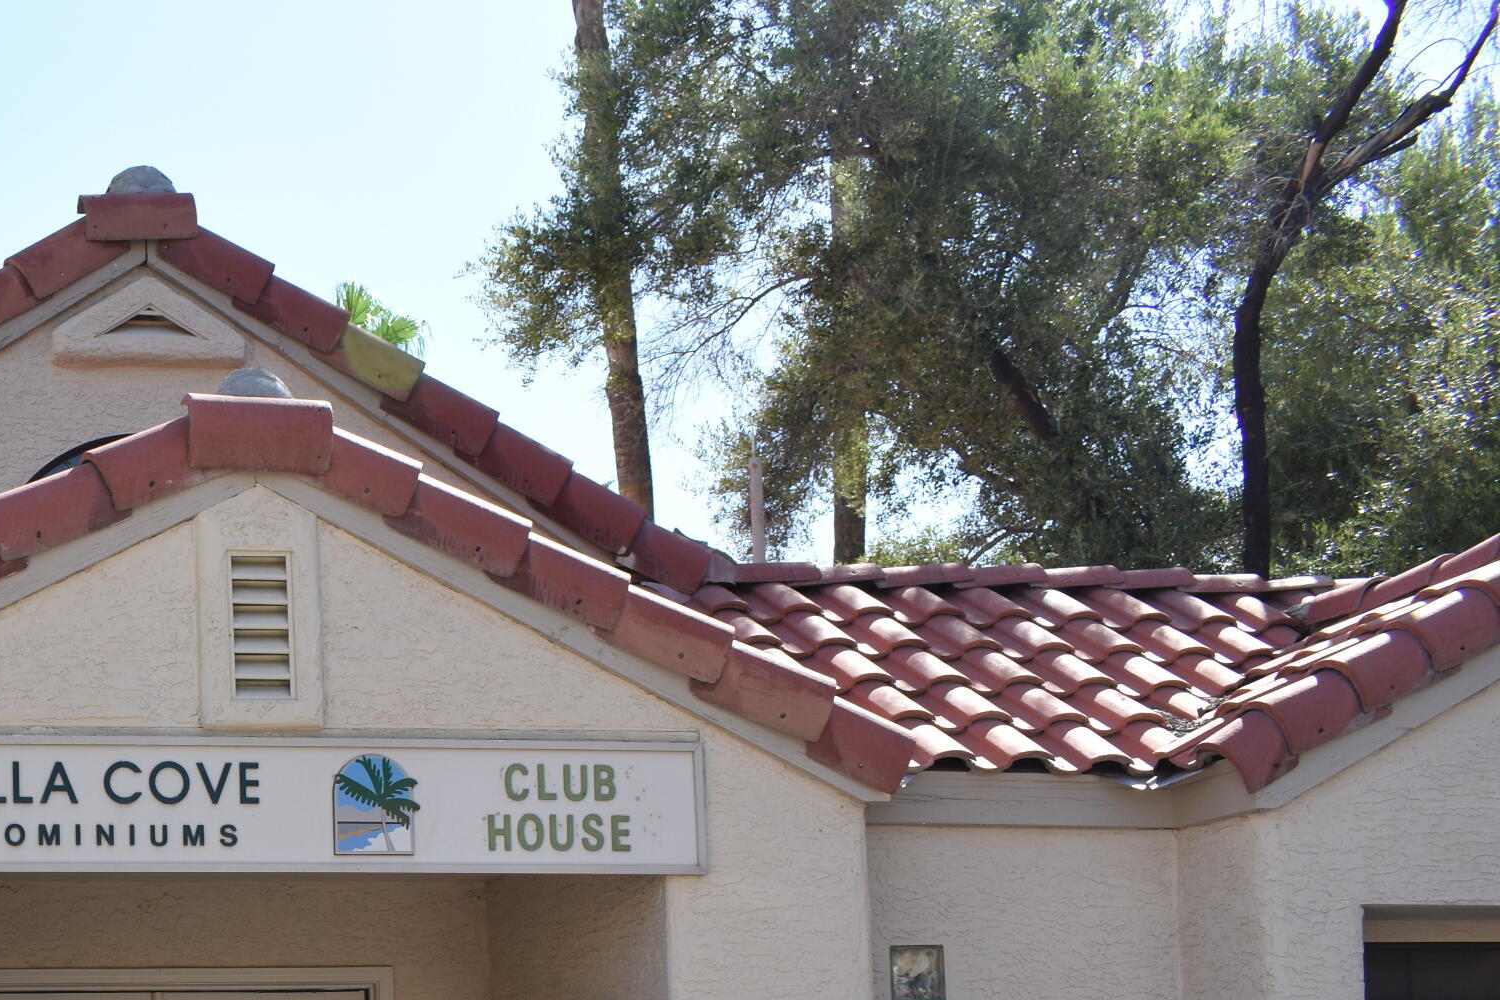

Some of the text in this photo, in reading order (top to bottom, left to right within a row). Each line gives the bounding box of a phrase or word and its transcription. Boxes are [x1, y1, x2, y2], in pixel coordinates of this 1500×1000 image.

[103, 760, 260, 804] COVE
[504, 763, 617, 801] CLUB
[487, 813, 632, 851] HOUSE
